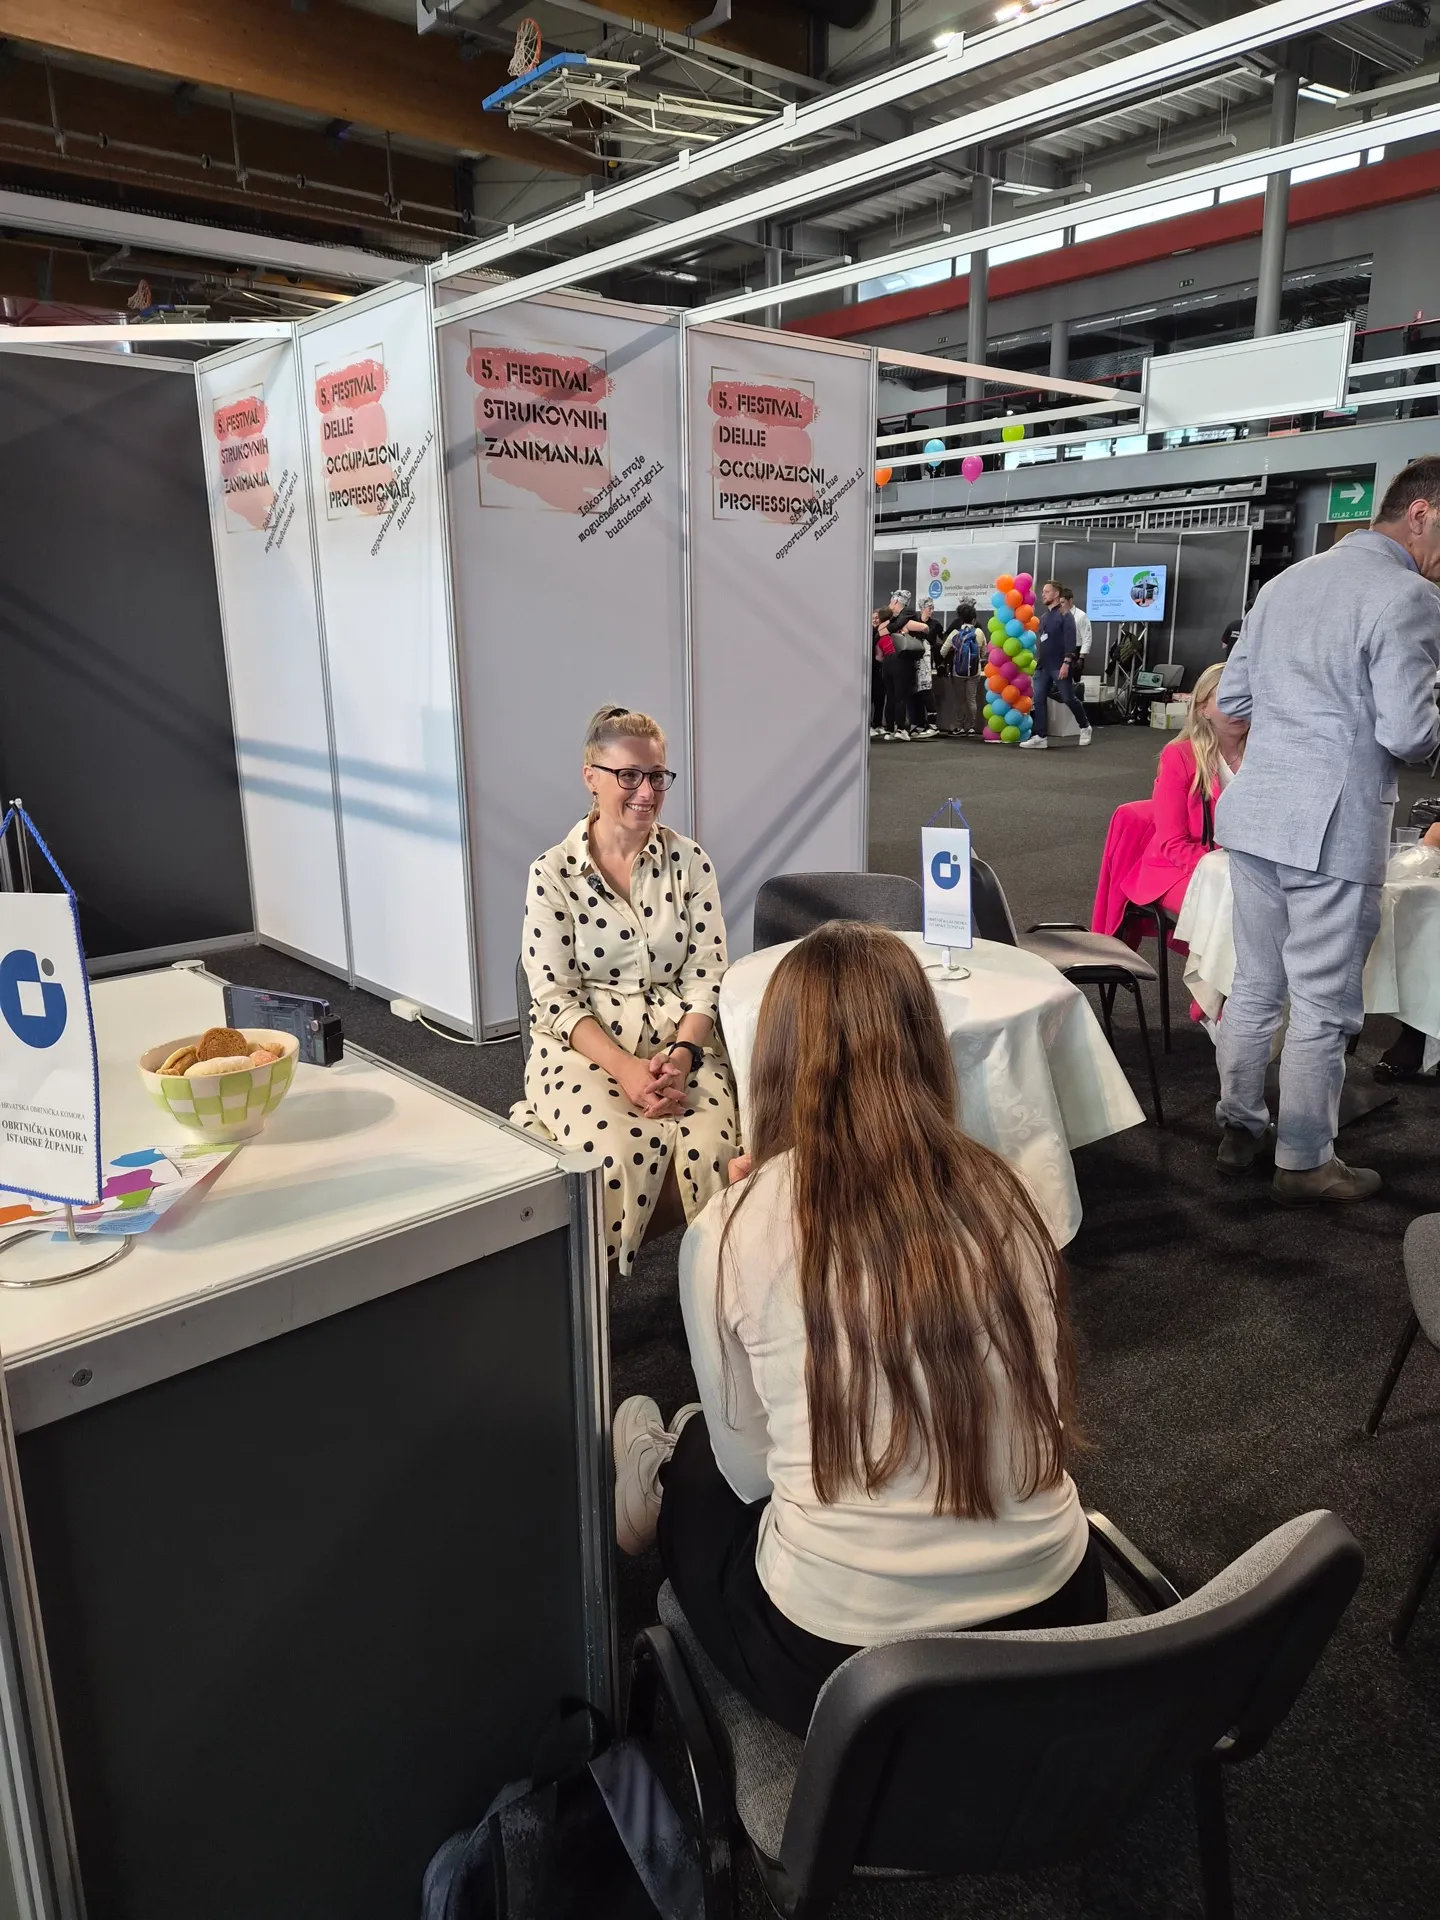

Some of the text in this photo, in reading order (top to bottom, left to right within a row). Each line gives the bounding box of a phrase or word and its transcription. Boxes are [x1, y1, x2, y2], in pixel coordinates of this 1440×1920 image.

[481, 358, 593, 393] 5. FESTIVAL
[320, 373, 377, 406] 5. FESTIVAL
[483, 398, 608, 431] STRUKOVNIH
[718, 391, 803, 419] 5. FESTIVAL
[218, 408, 260, 434] 5. FESTIVAL
[323, 416, 354, 441] DELLE
[719, 425, 767, 447] DELLE
[221, 437, 270, 465] STRUKOVNIH
[326, 443, 401, 475] OCCUPAZIONI
[401, 446, 412, 466] tue
[484, 436, 604, 467] ZANIMANJA
[223, 471, 271, 495] ZANIMANJA
[629, 460, 665, 498] prigrli
[719, 459, 825, 485] OCCUPAZIONI
[855, 467, 865, 480] il
[577, 454, 646, 518] Iskoristi svoje
[815, 487, 827, 500] le
[825, 474, 839, 490] tue
[397, 491, 417, 531] futuro!
[605, 492, 653, 539] budućnost!
[1331, 511, 1350, 519] IZLAZ
[813, 511, 840, 541] futuro!
[1, 1102, 86, 1120] HRVATSKA OBRTNIČKA KOMORA
[1, 1119, 88, 1142] OBRTNIČKA KOMORA
[6, 1132, 85, 1155] ISTARSKE ŽUPANIJE
